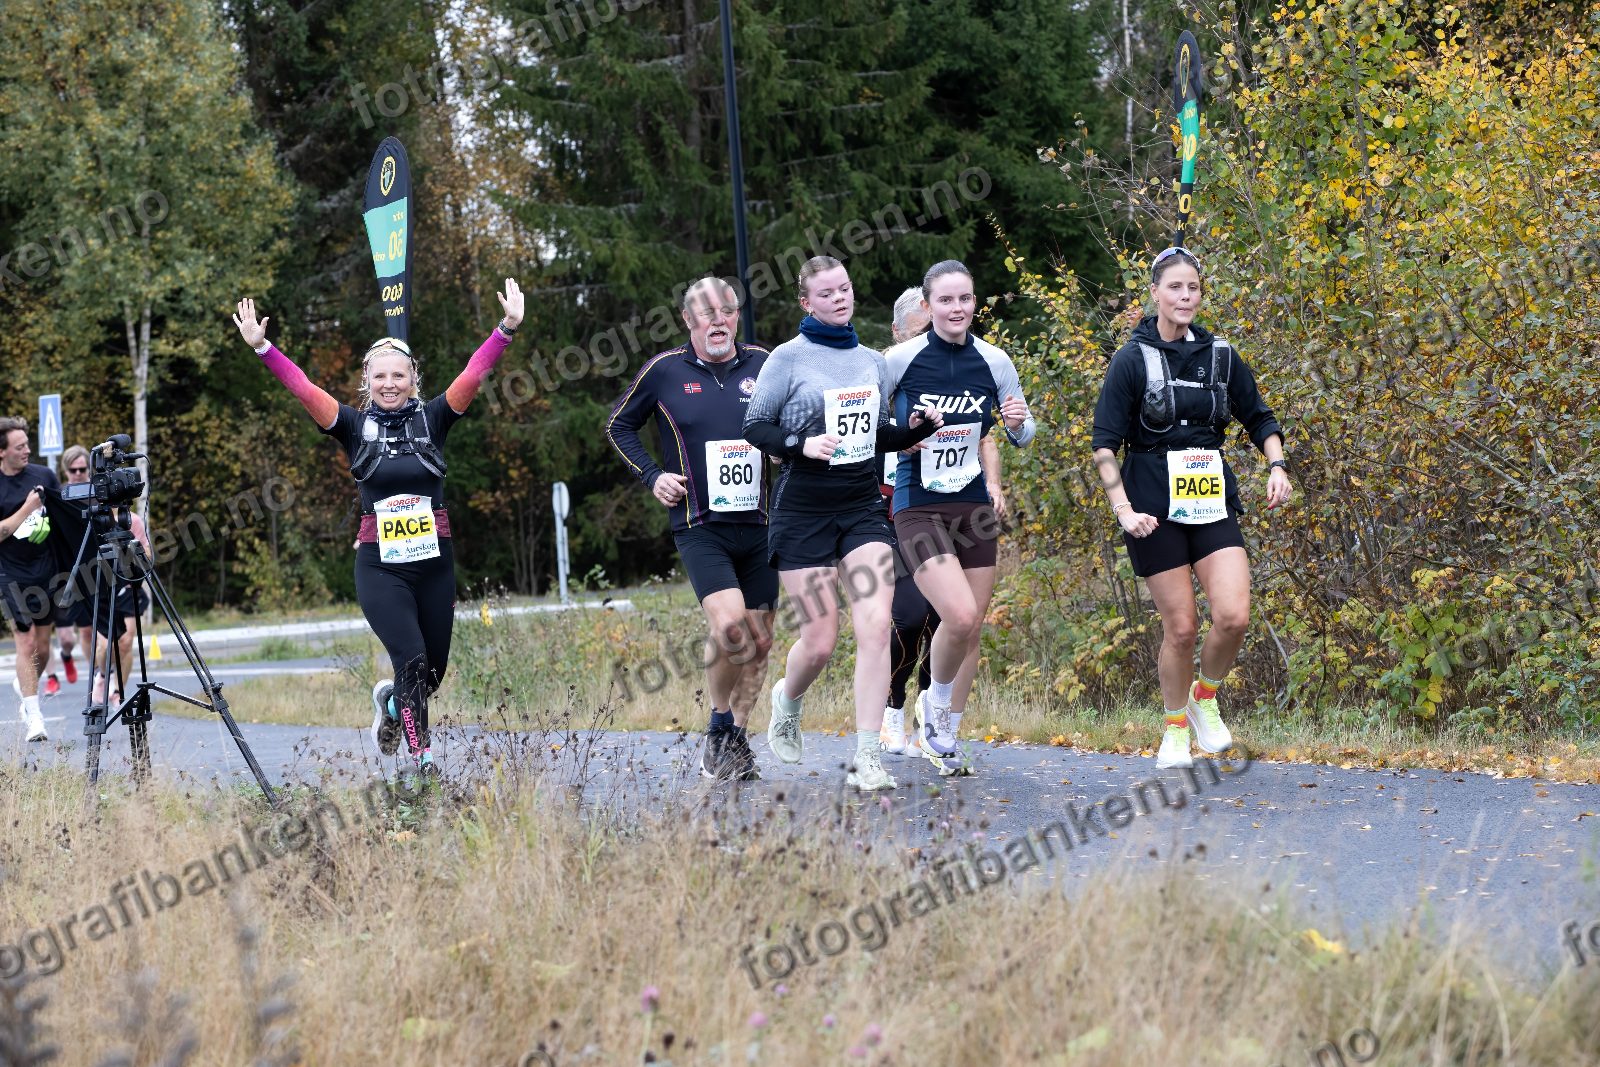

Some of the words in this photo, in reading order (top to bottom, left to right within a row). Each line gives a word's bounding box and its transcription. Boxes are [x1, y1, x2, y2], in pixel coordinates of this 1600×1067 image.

[837, 391, 872, 401] NORGES
[841, 399, 867, 407] LØPET
[837, 411, 871, 437] 573
[935, 429, 971, 437] NORGES
[932, 446, 968, 470] 707
[719, 464, 753, 485] 860
[1176, 477, 1220, 496] PACE
[387, 497, 421, 507] NORGES
[383, 516, 431, 538] PACE
